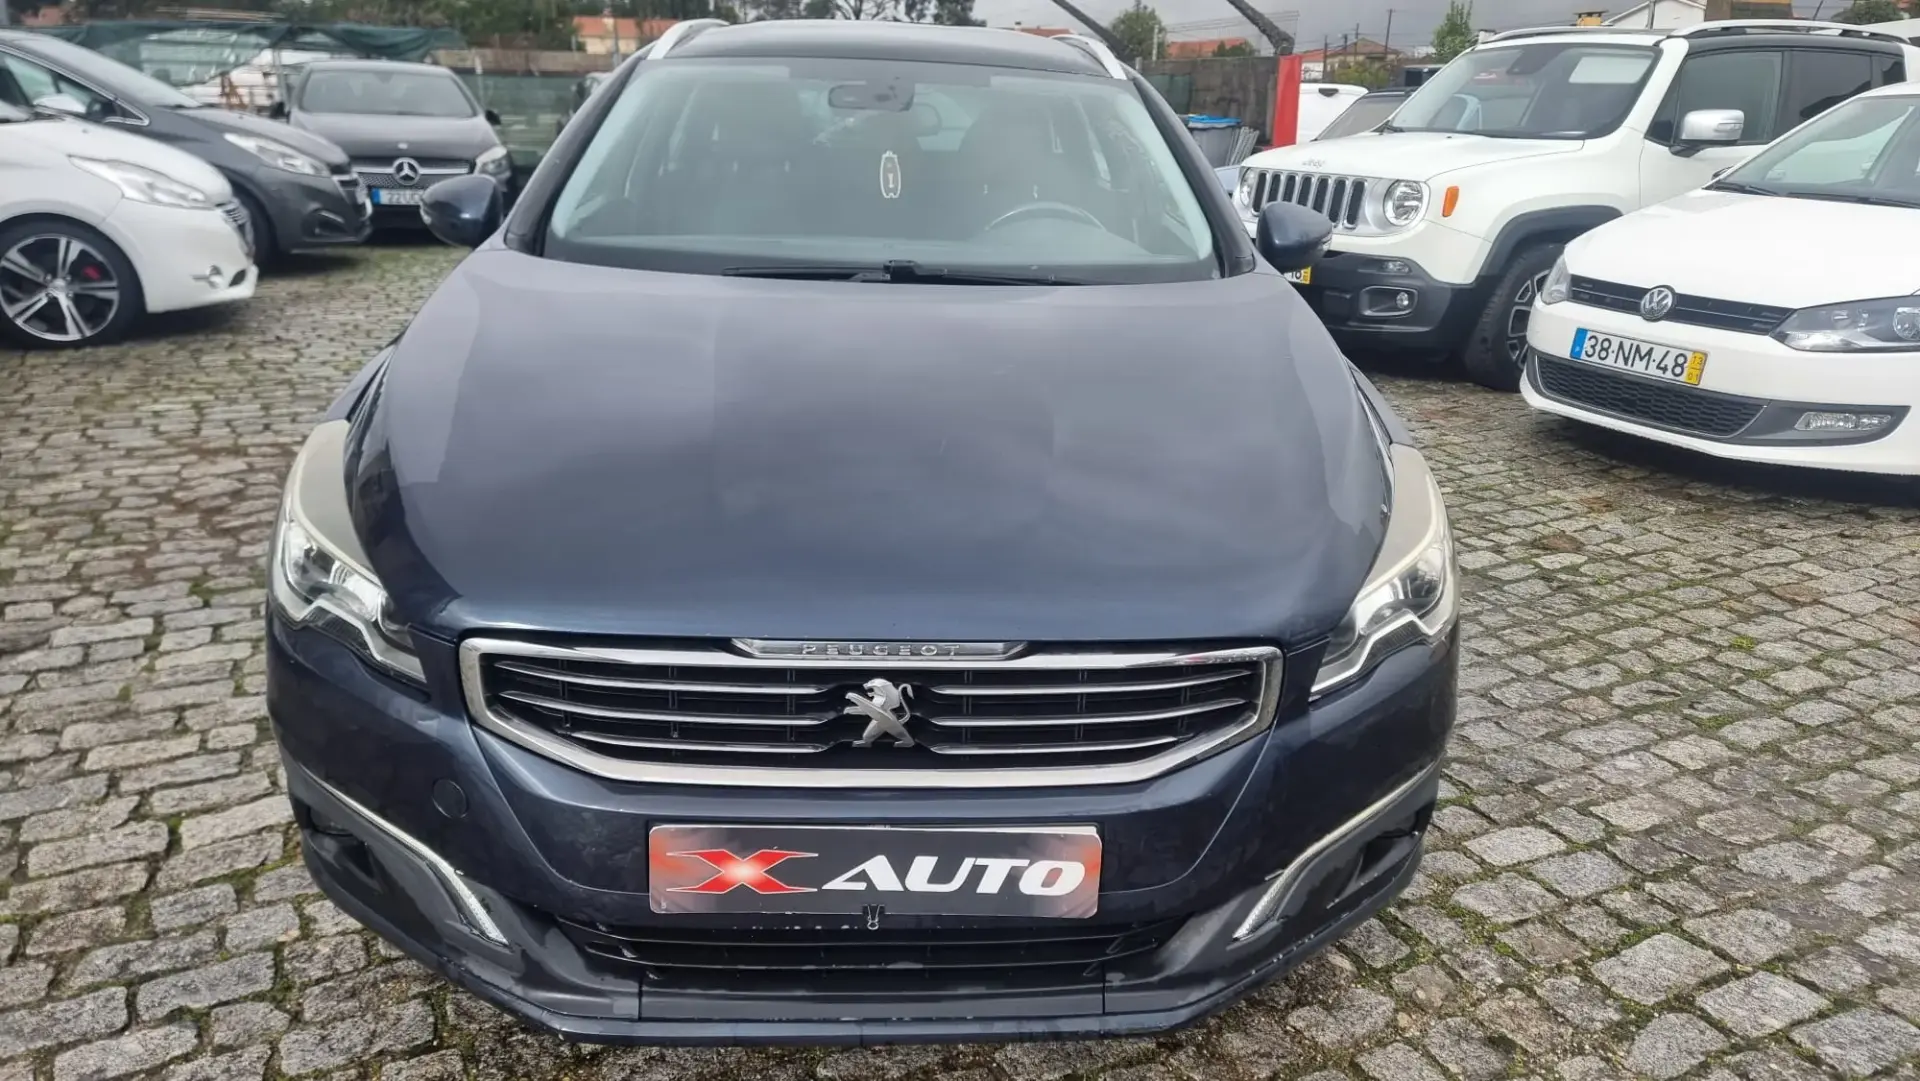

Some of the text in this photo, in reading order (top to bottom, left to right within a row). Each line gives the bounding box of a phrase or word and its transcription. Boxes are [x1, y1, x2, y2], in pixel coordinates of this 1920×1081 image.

[802, 644, 960, 656] PEUGEOT
[666, 849, 1086, 896] X AUTO
